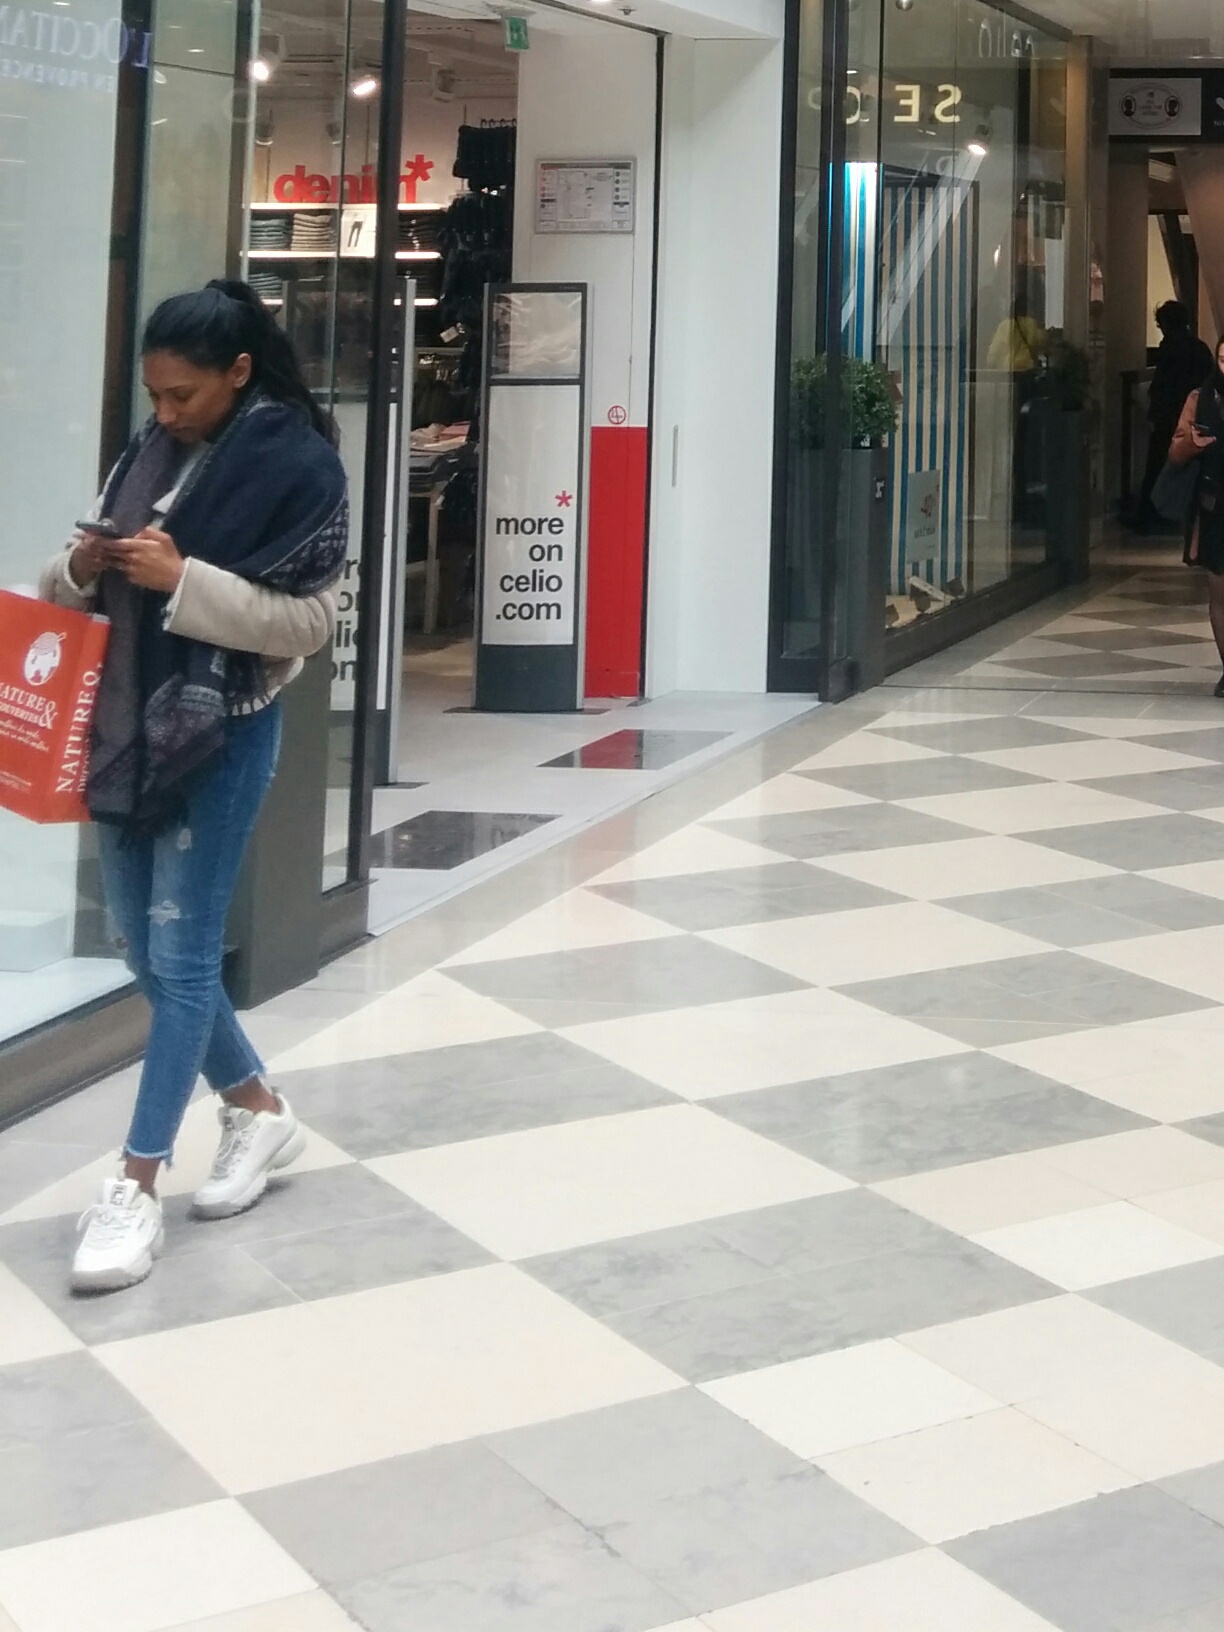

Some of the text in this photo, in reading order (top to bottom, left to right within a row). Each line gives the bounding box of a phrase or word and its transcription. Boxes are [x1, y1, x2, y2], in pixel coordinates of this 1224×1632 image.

[496, 514, 564, 536] more
[529, 545, 563, 563] on
[499, 570, 563, 594] celio
[495, 600, 562, 622] .com
